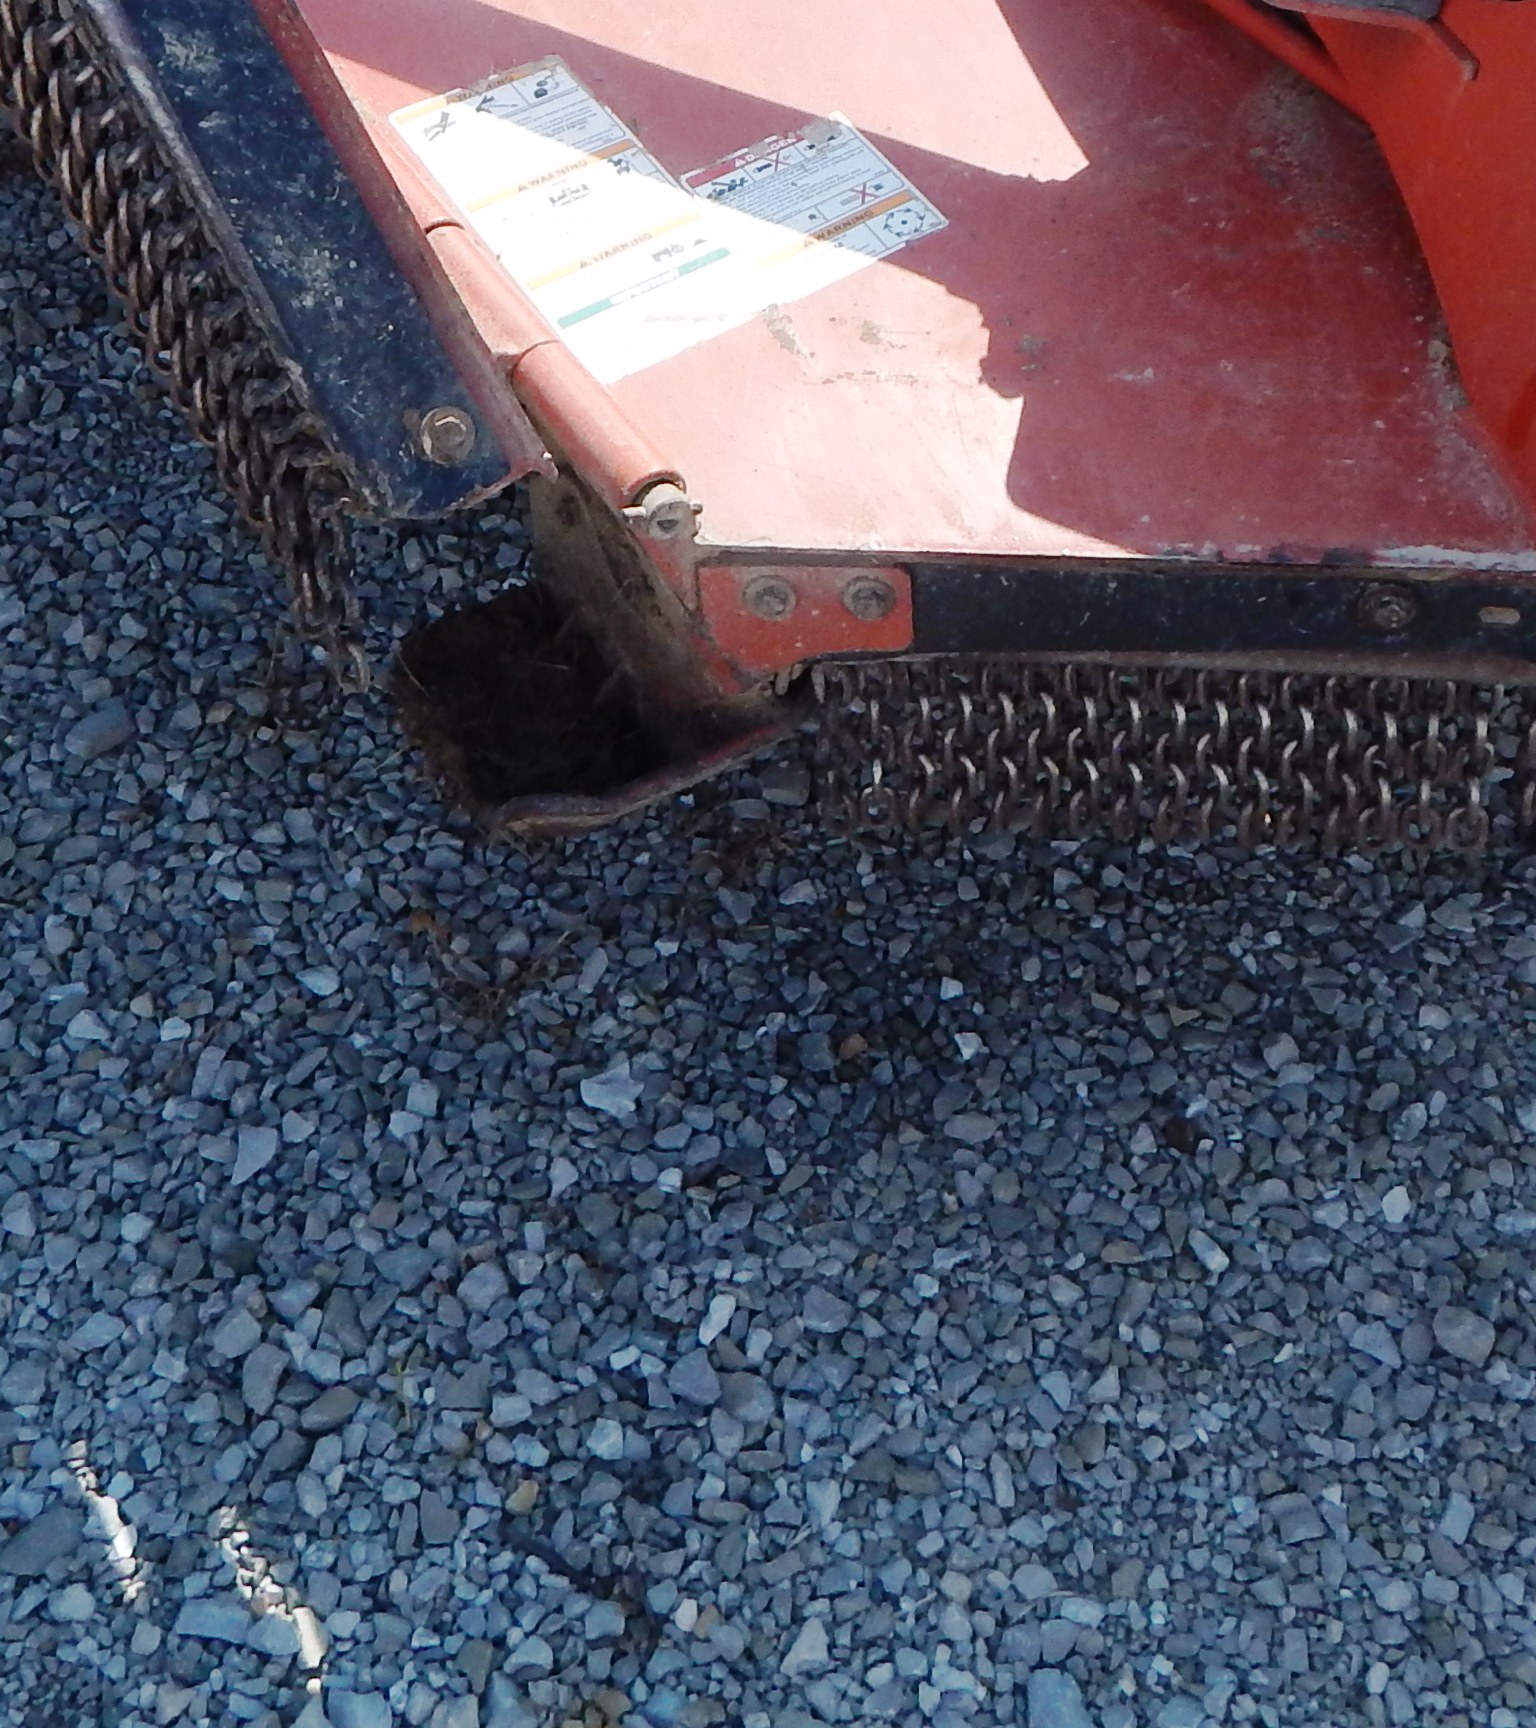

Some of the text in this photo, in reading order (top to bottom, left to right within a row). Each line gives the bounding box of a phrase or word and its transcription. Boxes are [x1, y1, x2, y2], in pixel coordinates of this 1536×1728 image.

[527, 158, 589, 190] WARNING
[814, 208, 875, 241] WARNING
[593, 232, 654, 264] WARNING
